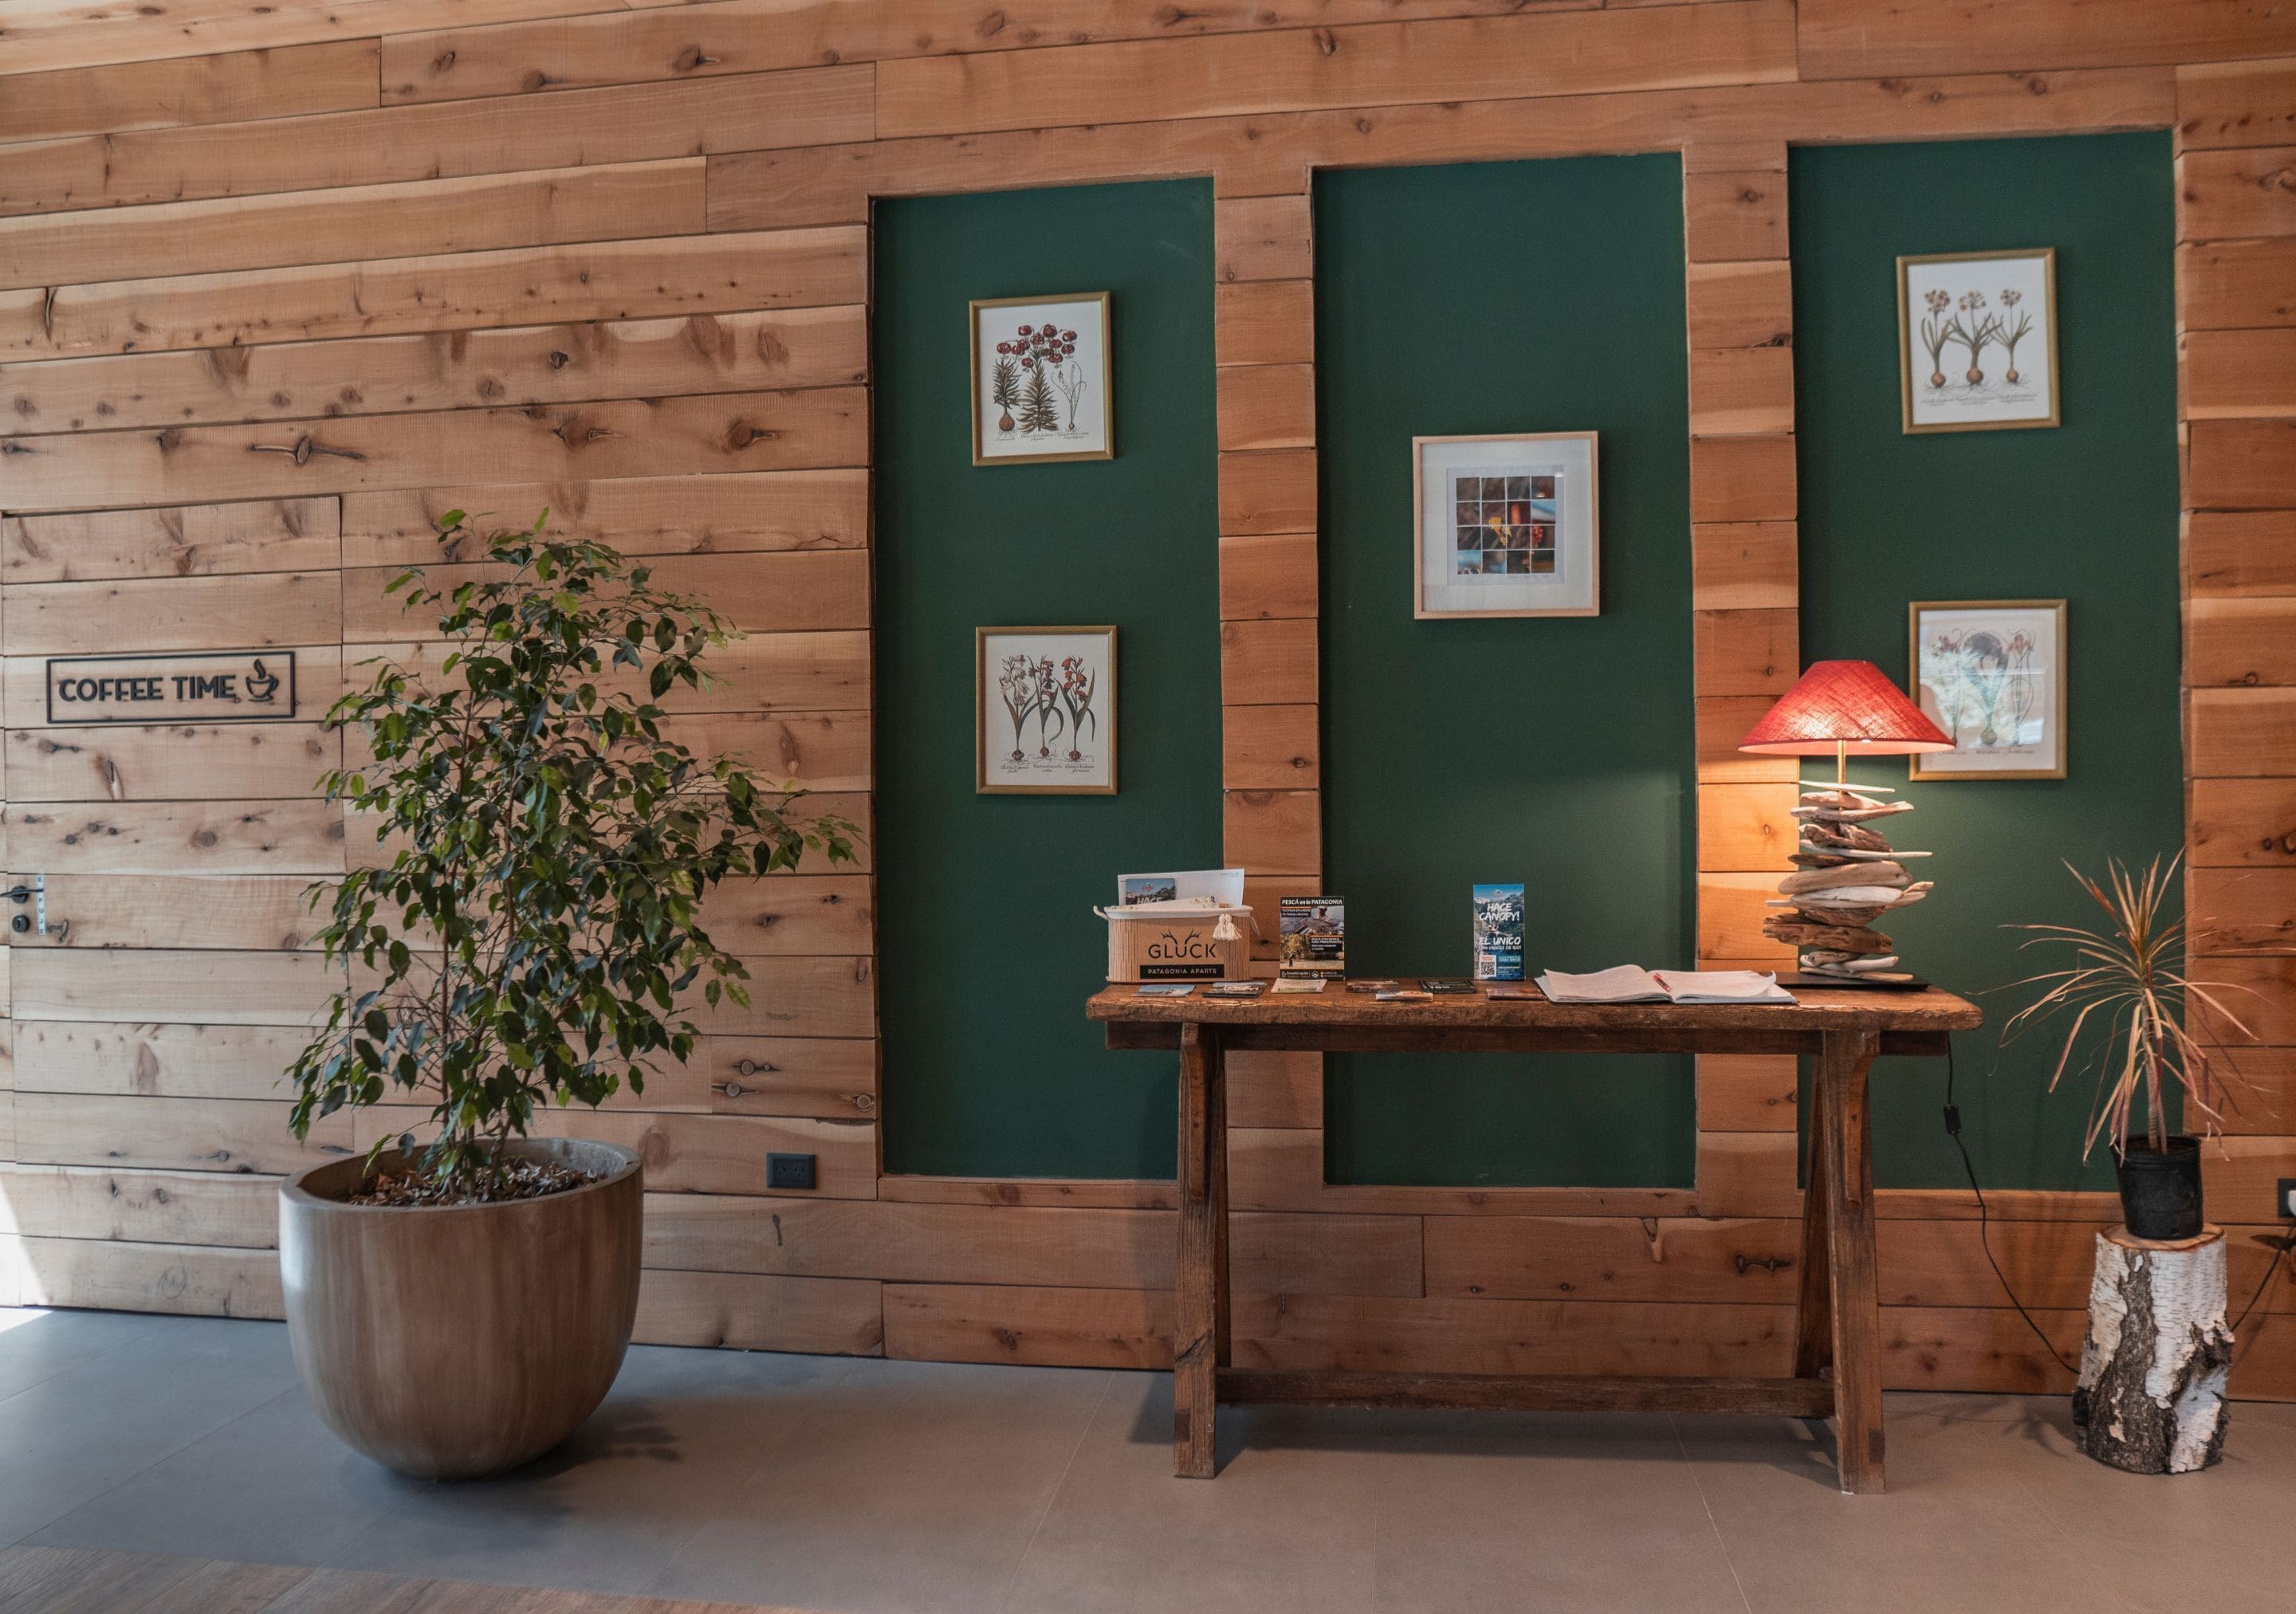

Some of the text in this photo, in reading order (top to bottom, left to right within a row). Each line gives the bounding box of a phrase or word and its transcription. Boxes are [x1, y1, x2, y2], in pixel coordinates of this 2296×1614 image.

[58, 675, 237, 701] COFFEE TIME
[1487, 903, 1512, 912] HACE
[1479, 910, 1520, 921] CANOPY!
[1479, 937, 1492, 945] EL
